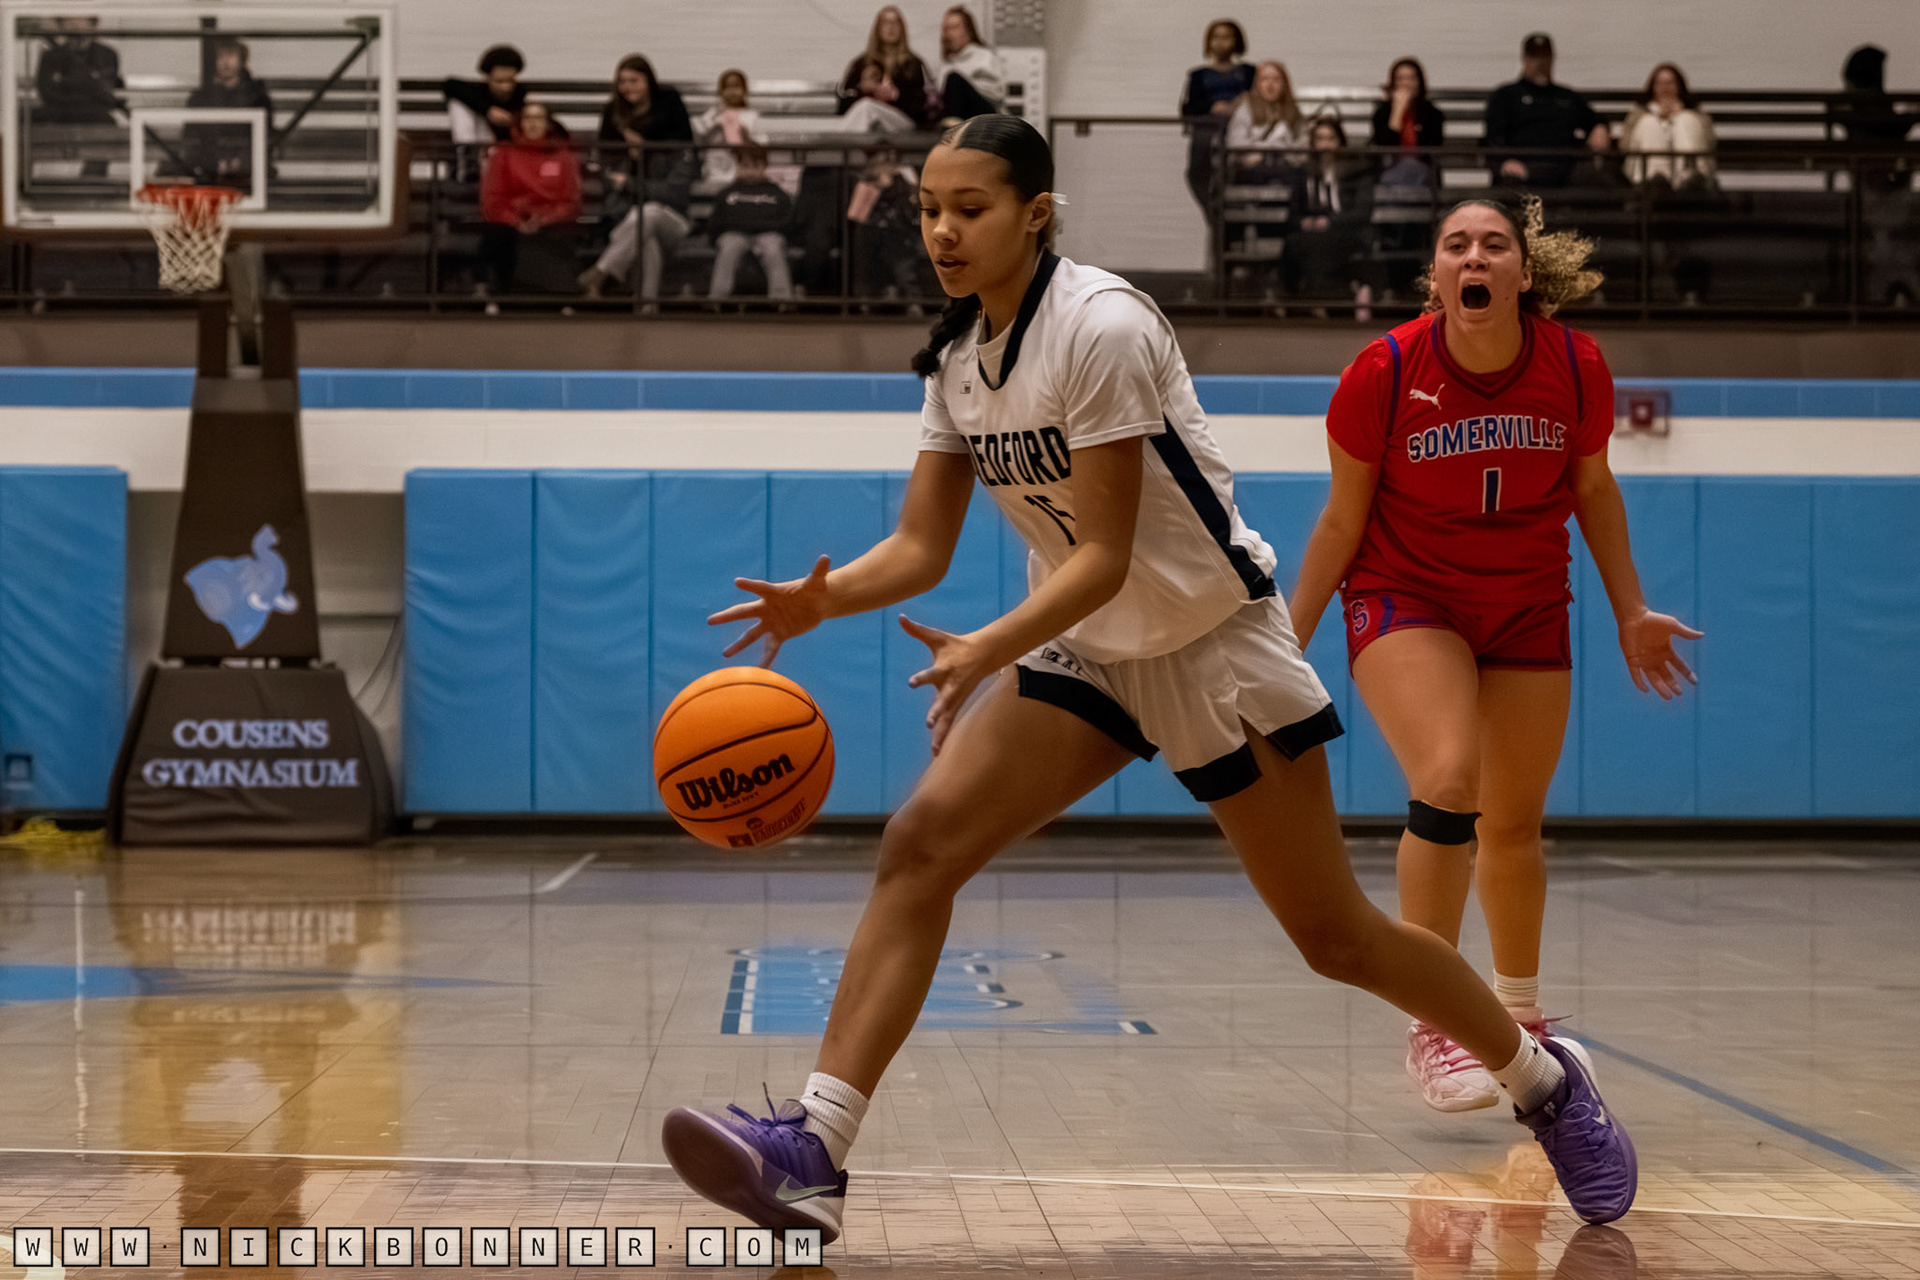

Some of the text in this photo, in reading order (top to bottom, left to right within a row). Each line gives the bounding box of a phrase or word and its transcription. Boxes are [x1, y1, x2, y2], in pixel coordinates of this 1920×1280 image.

[960, 426, 1071, 486] EDFORD
[1407, 415, 1567, 463] SOMERVILLE
[1482, 467, 1501, 514] 1
[1351, 599, 1369, 635] S
[172, 719, 329, 748] COUSENS
[142, 758, 359, 788] GYMNASIUM
[676, 753, 795, 811] Wilson
